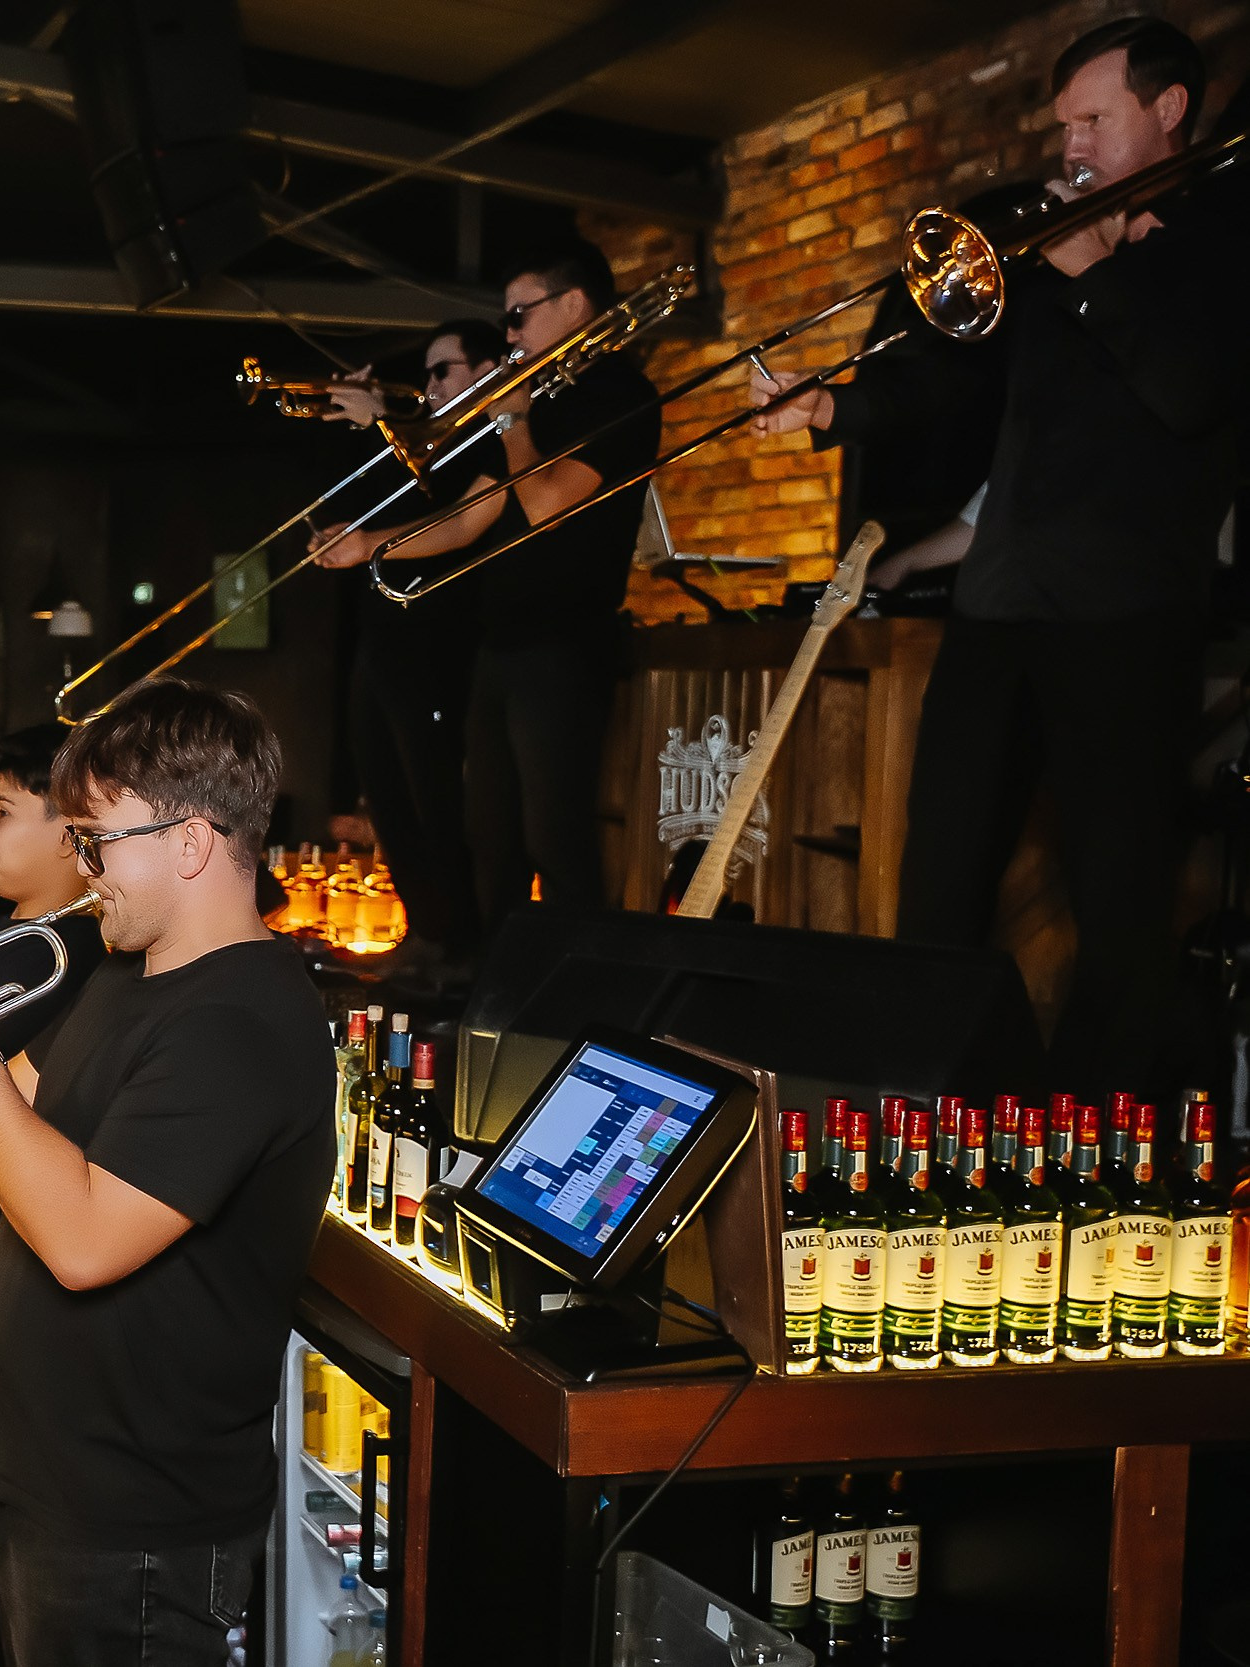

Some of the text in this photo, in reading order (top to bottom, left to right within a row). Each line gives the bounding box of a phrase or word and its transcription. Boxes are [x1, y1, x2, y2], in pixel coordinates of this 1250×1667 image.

[1010, 1228, 1059, 1245] JAMES
[1117, 1222, 1171, 1237] AMESO
[1178, 1222, 1231, 1238] JAMES
[784, 1234, 823, 1250] AMES
[827, 1235, 885, 1250] JAMESO
[892, 1233, 945, 1250] JAMES
[952, 1230, 1002, 1247] JAMES
[824, 1533, 865, 1551] JAMES
[872, 1530, 918, 1545] JAMES
